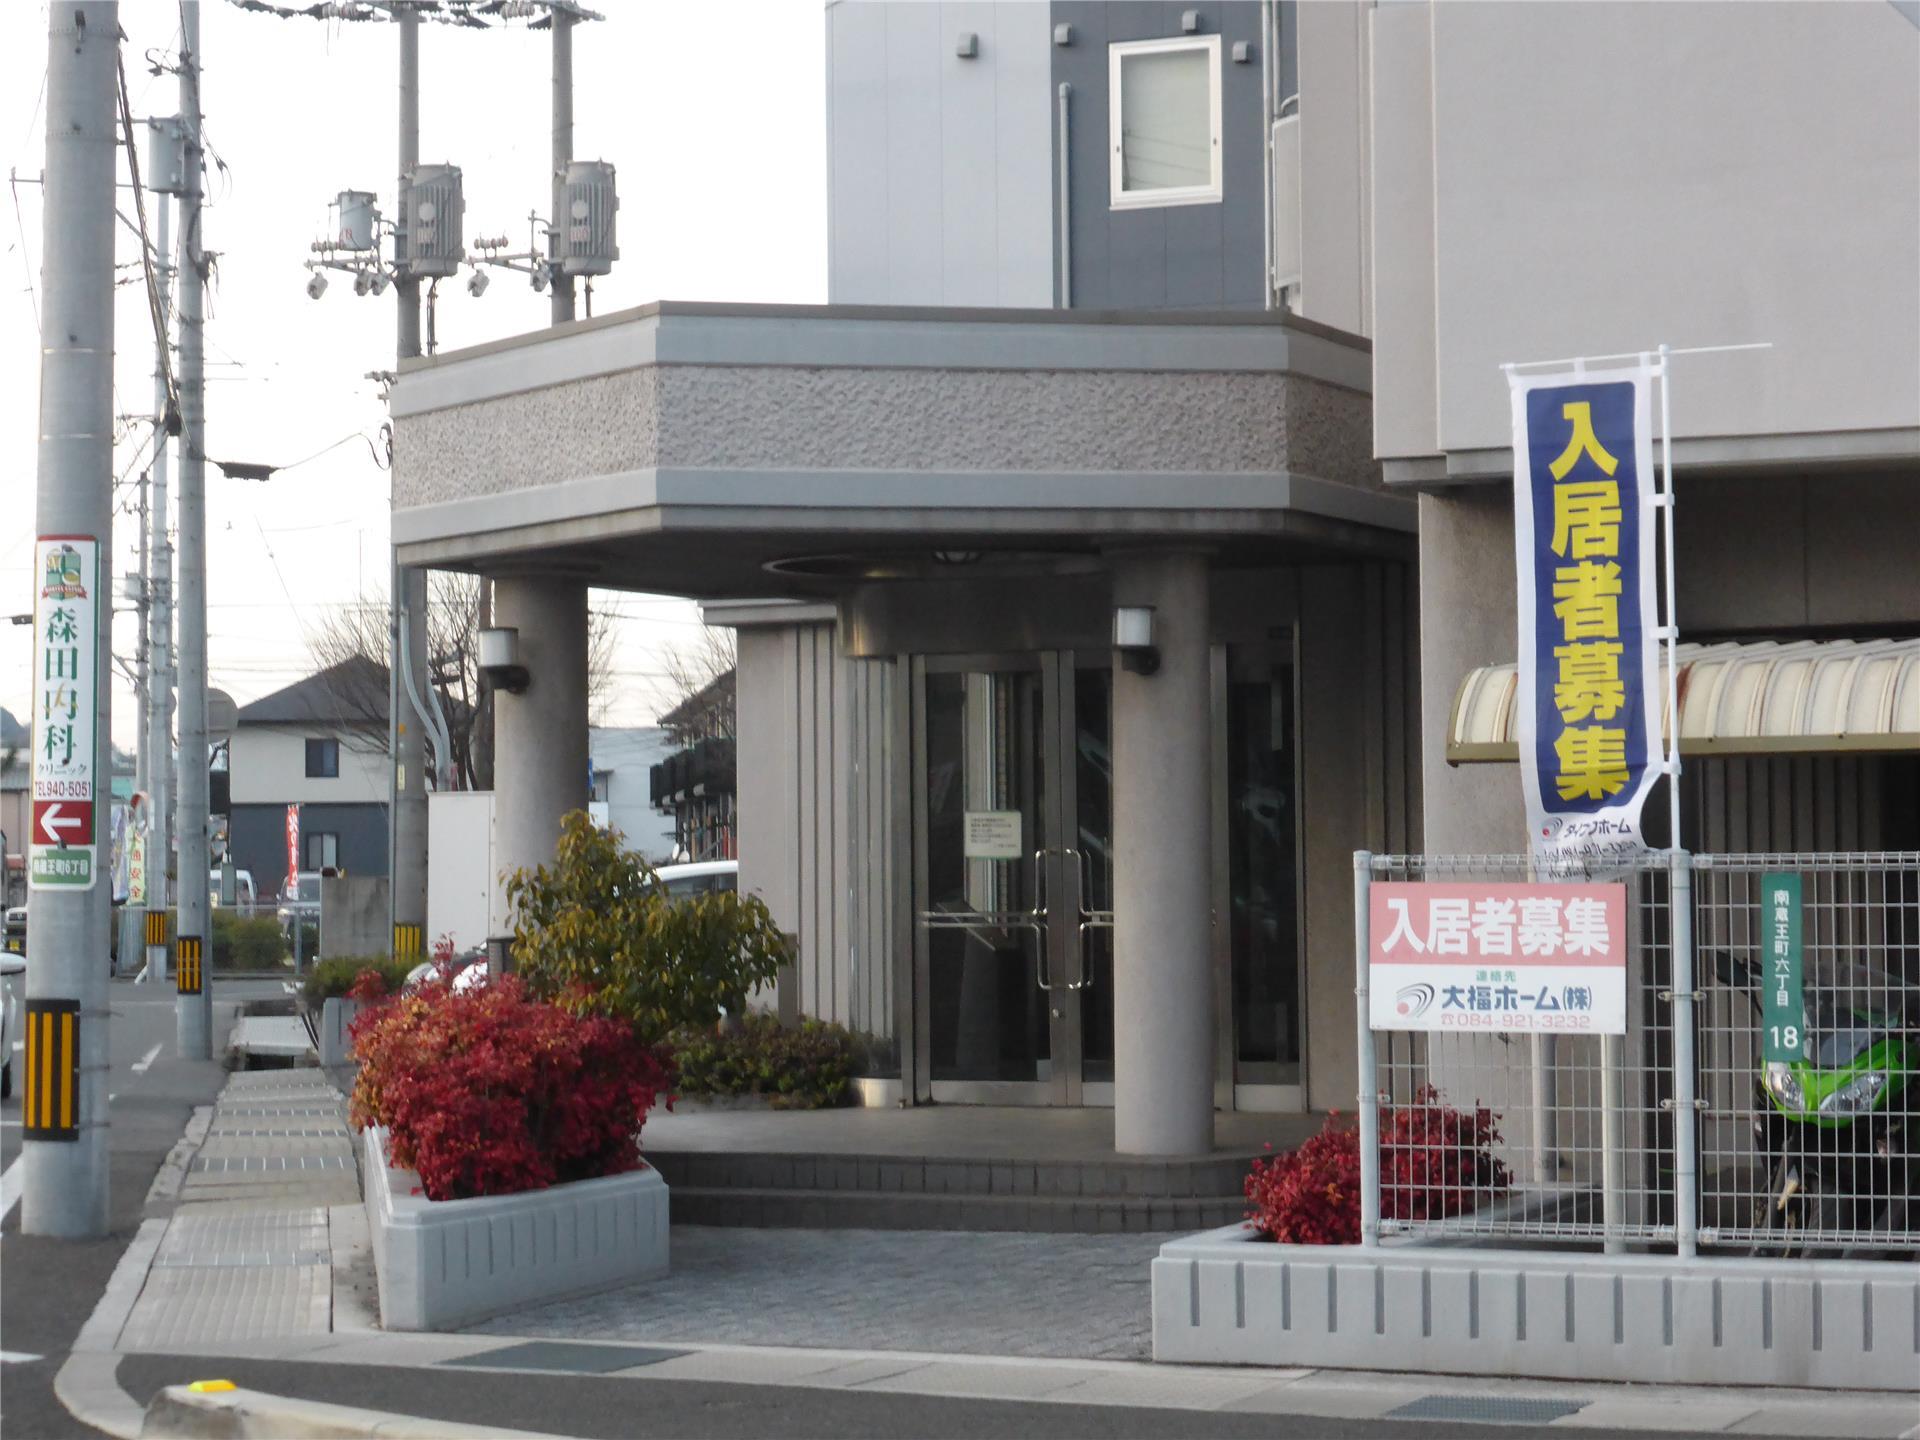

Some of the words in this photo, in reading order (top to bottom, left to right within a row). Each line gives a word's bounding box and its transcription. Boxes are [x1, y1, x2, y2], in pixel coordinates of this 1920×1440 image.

[1548, 401, 1630, 800] 入居者募集
[44, 606, 79, 764] 森田内科
[1381, 897, 1610, 957] 入居者募集
[1774, 889, 1790, 1007] 南蔵王町六丁目
[1442, 985, 1593, 1011] 大福ホーム(株)
[1476, 970, 1516, 982] 連絡先
[1770, 1025, 1799, 1049] 18
